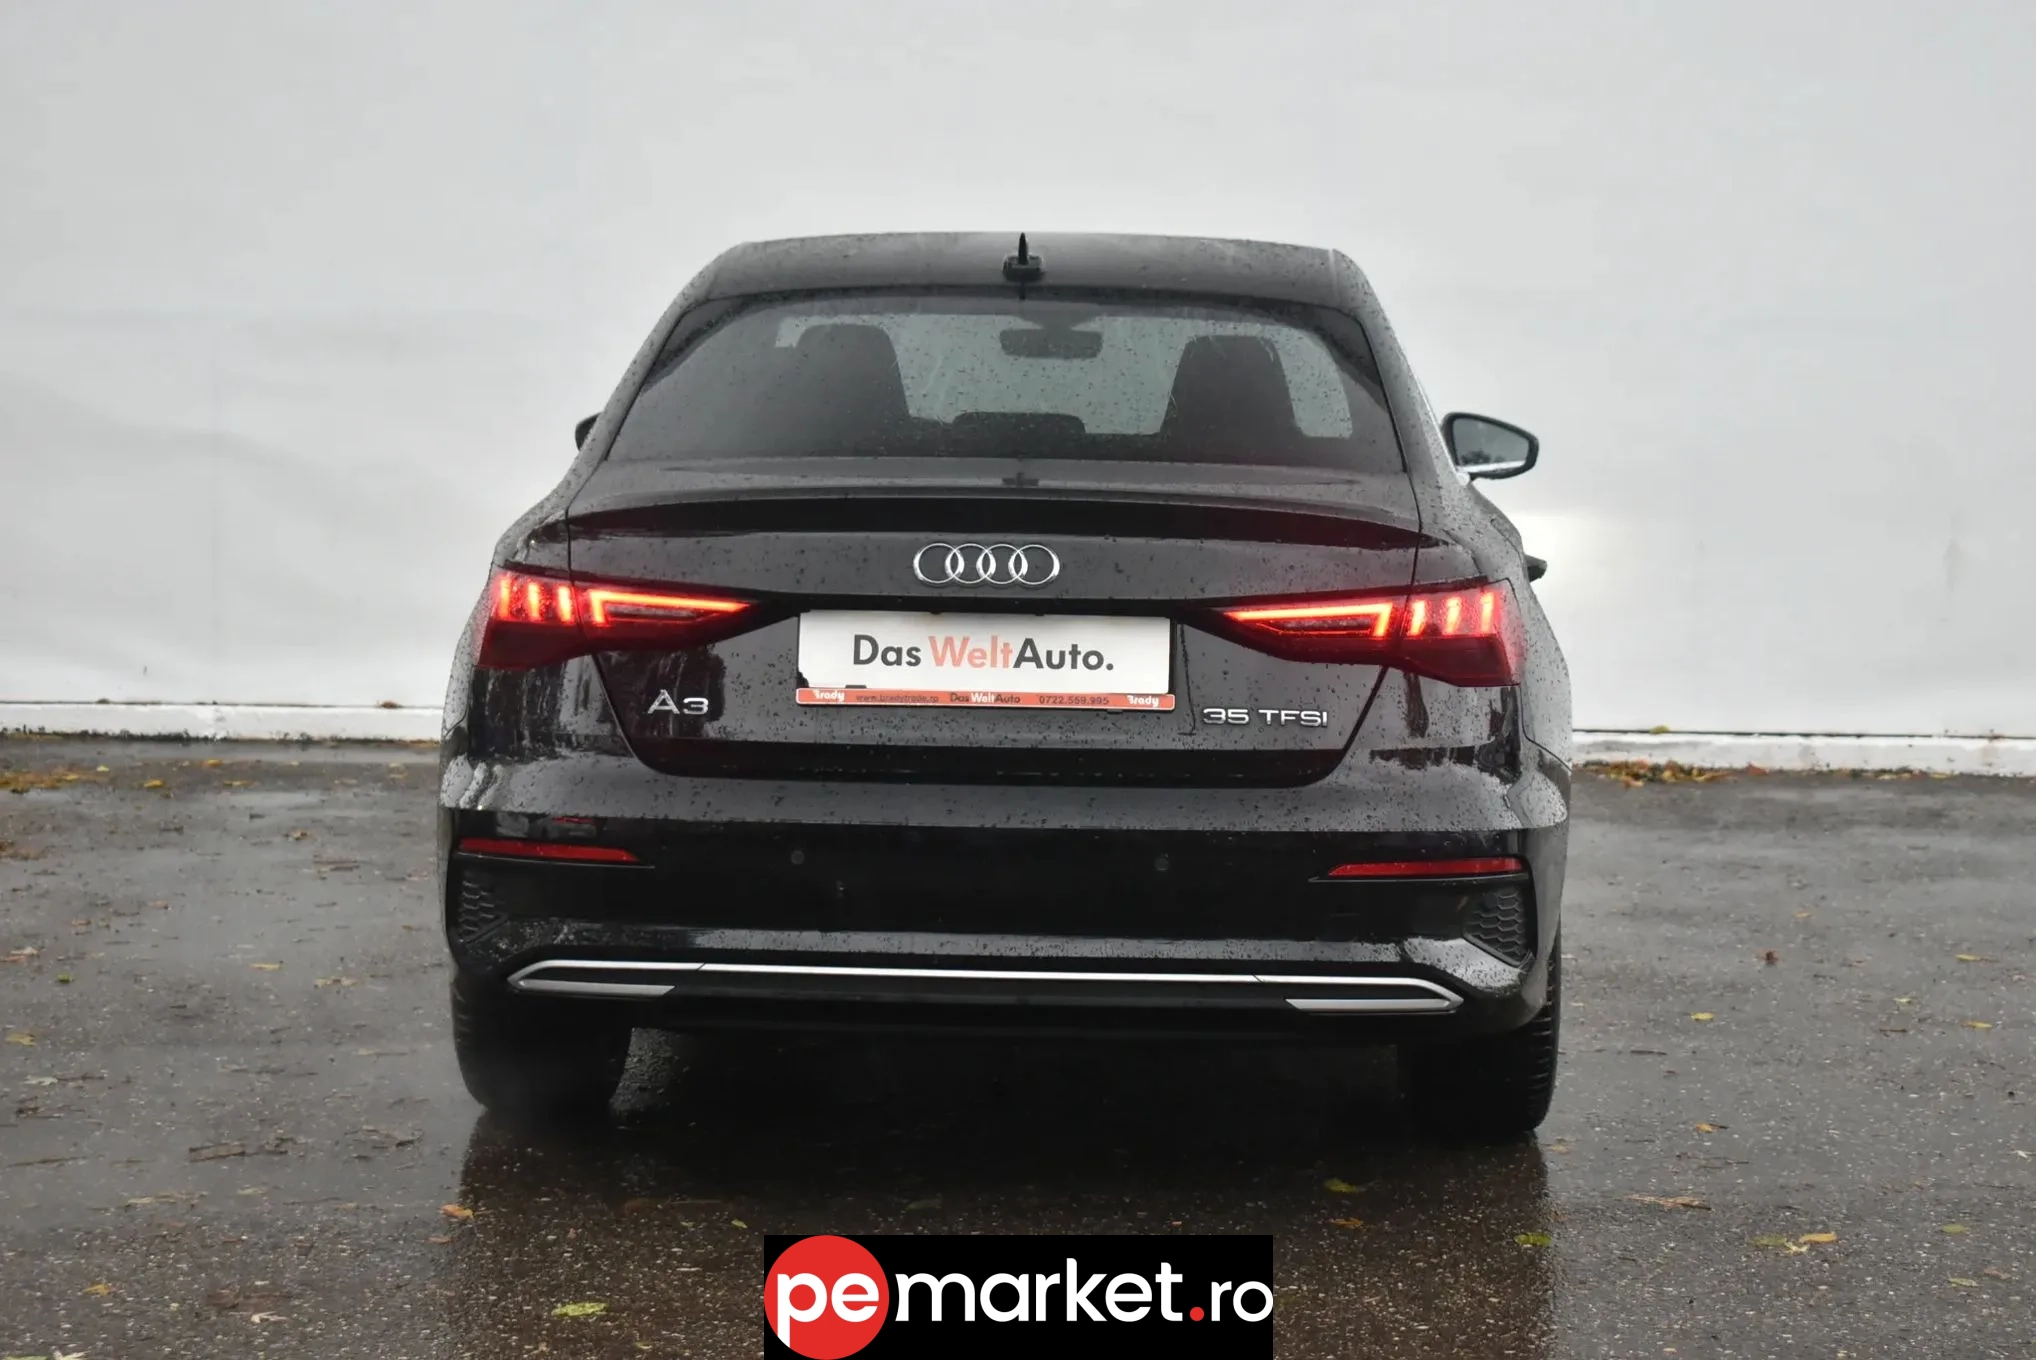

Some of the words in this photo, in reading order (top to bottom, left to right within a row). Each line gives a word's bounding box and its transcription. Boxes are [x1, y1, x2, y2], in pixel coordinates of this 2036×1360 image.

[853, 634, 922, 667] Das
[928, 635, 1114, 670] WeltAuto.
[647, 689, 709, 714] A3
[950, 692, 970, 703] Das
[1203, 708, 1249, 724] 35
[1258, 709, 1328, 727] TFSI
